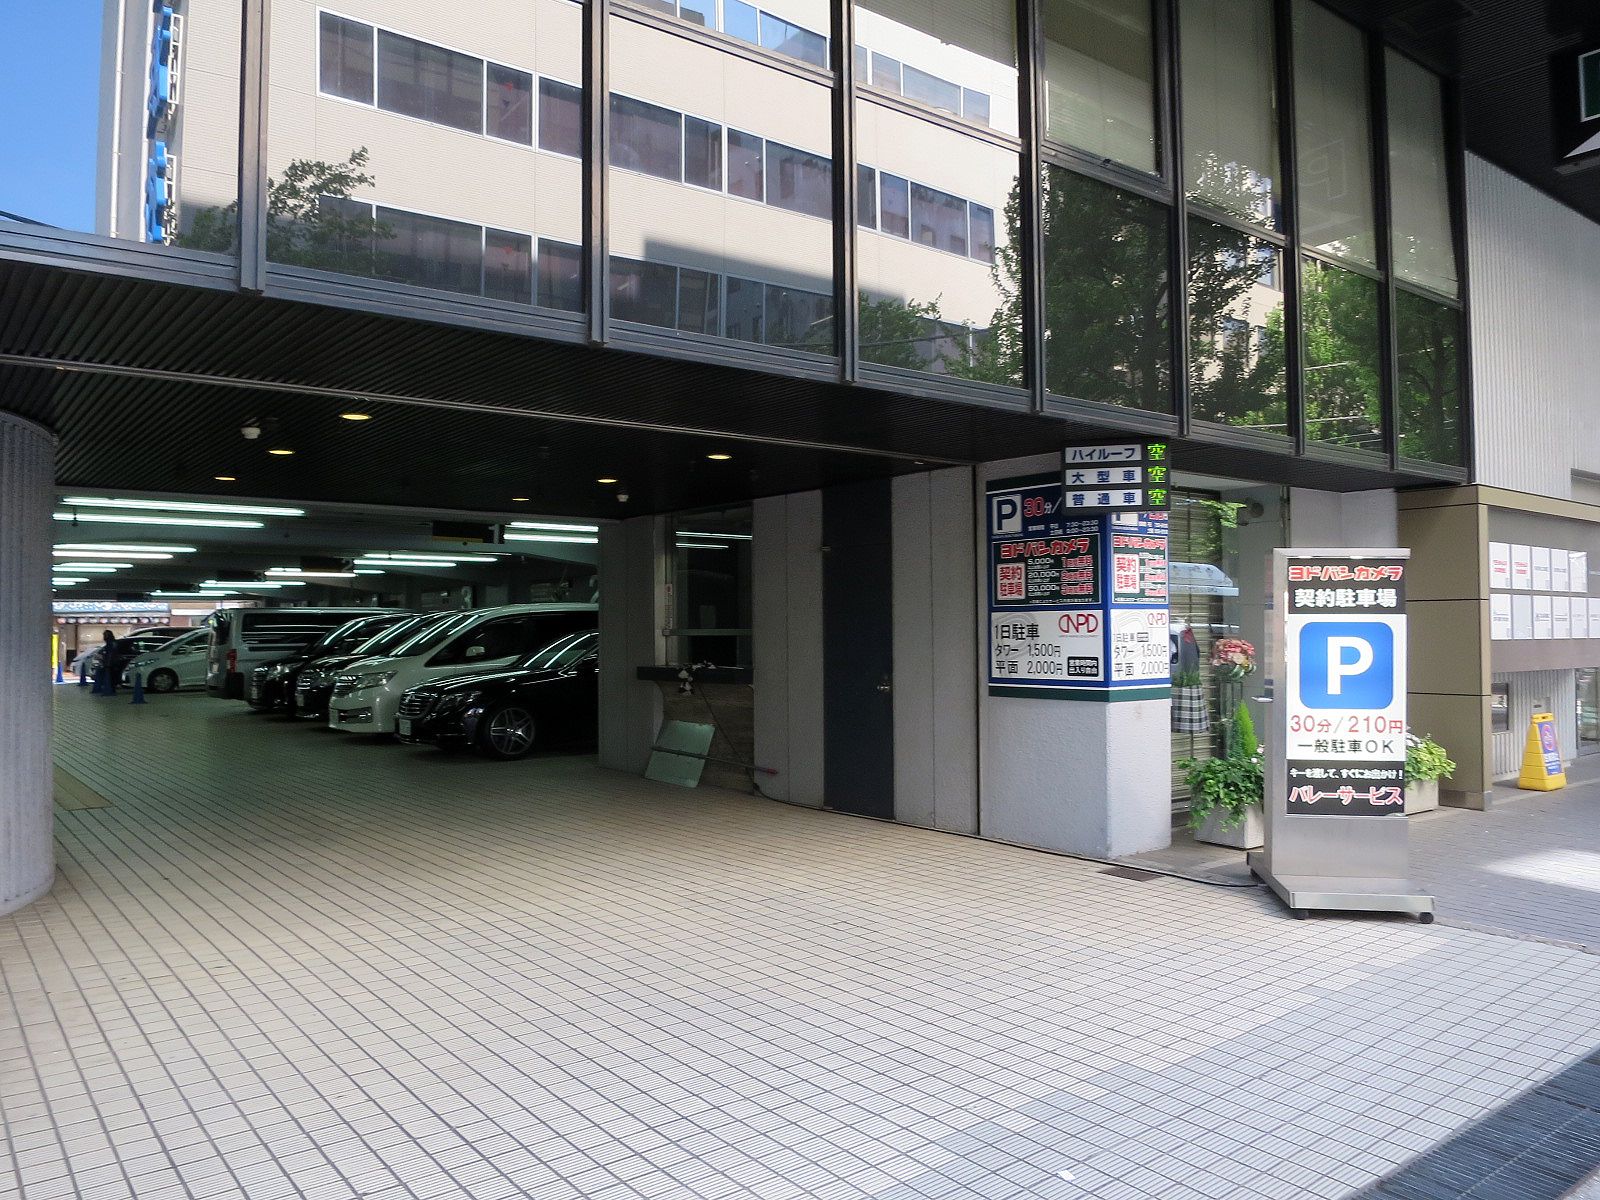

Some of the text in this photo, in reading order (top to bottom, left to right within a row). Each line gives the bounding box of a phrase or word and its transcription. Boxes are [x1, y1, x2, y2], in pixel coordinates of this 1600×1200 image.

[1072, 443, 1166, 461] ハイルーフ 空
[1072, 466, 1166, 484] 大型車 空
[1072, 488, 1167, 506] 普通車 空
[996, 498, 1017, 531] P
[1000, 538, 1089, 558] ヨドバシカメラ
[999, 566, 1022, 580] 契約
[1289, 565, 1403, 581] ヨドバシカメラ
[999, 582, 1023, 597] 駐車場
[1295, 588, 1398, 608] 契約駐車場
[995, 623, 1040, 641] 1日駐車
[995, 643, 1061, 658] タワー 1,500円
[995, 660, 1063, 676] 平面 2,000円
[1327, 636, 1374, 695] P
[1297, 739, 1394, 755] 一般駐車OK
[1289, 785, 1403, 805] バレーサービス
